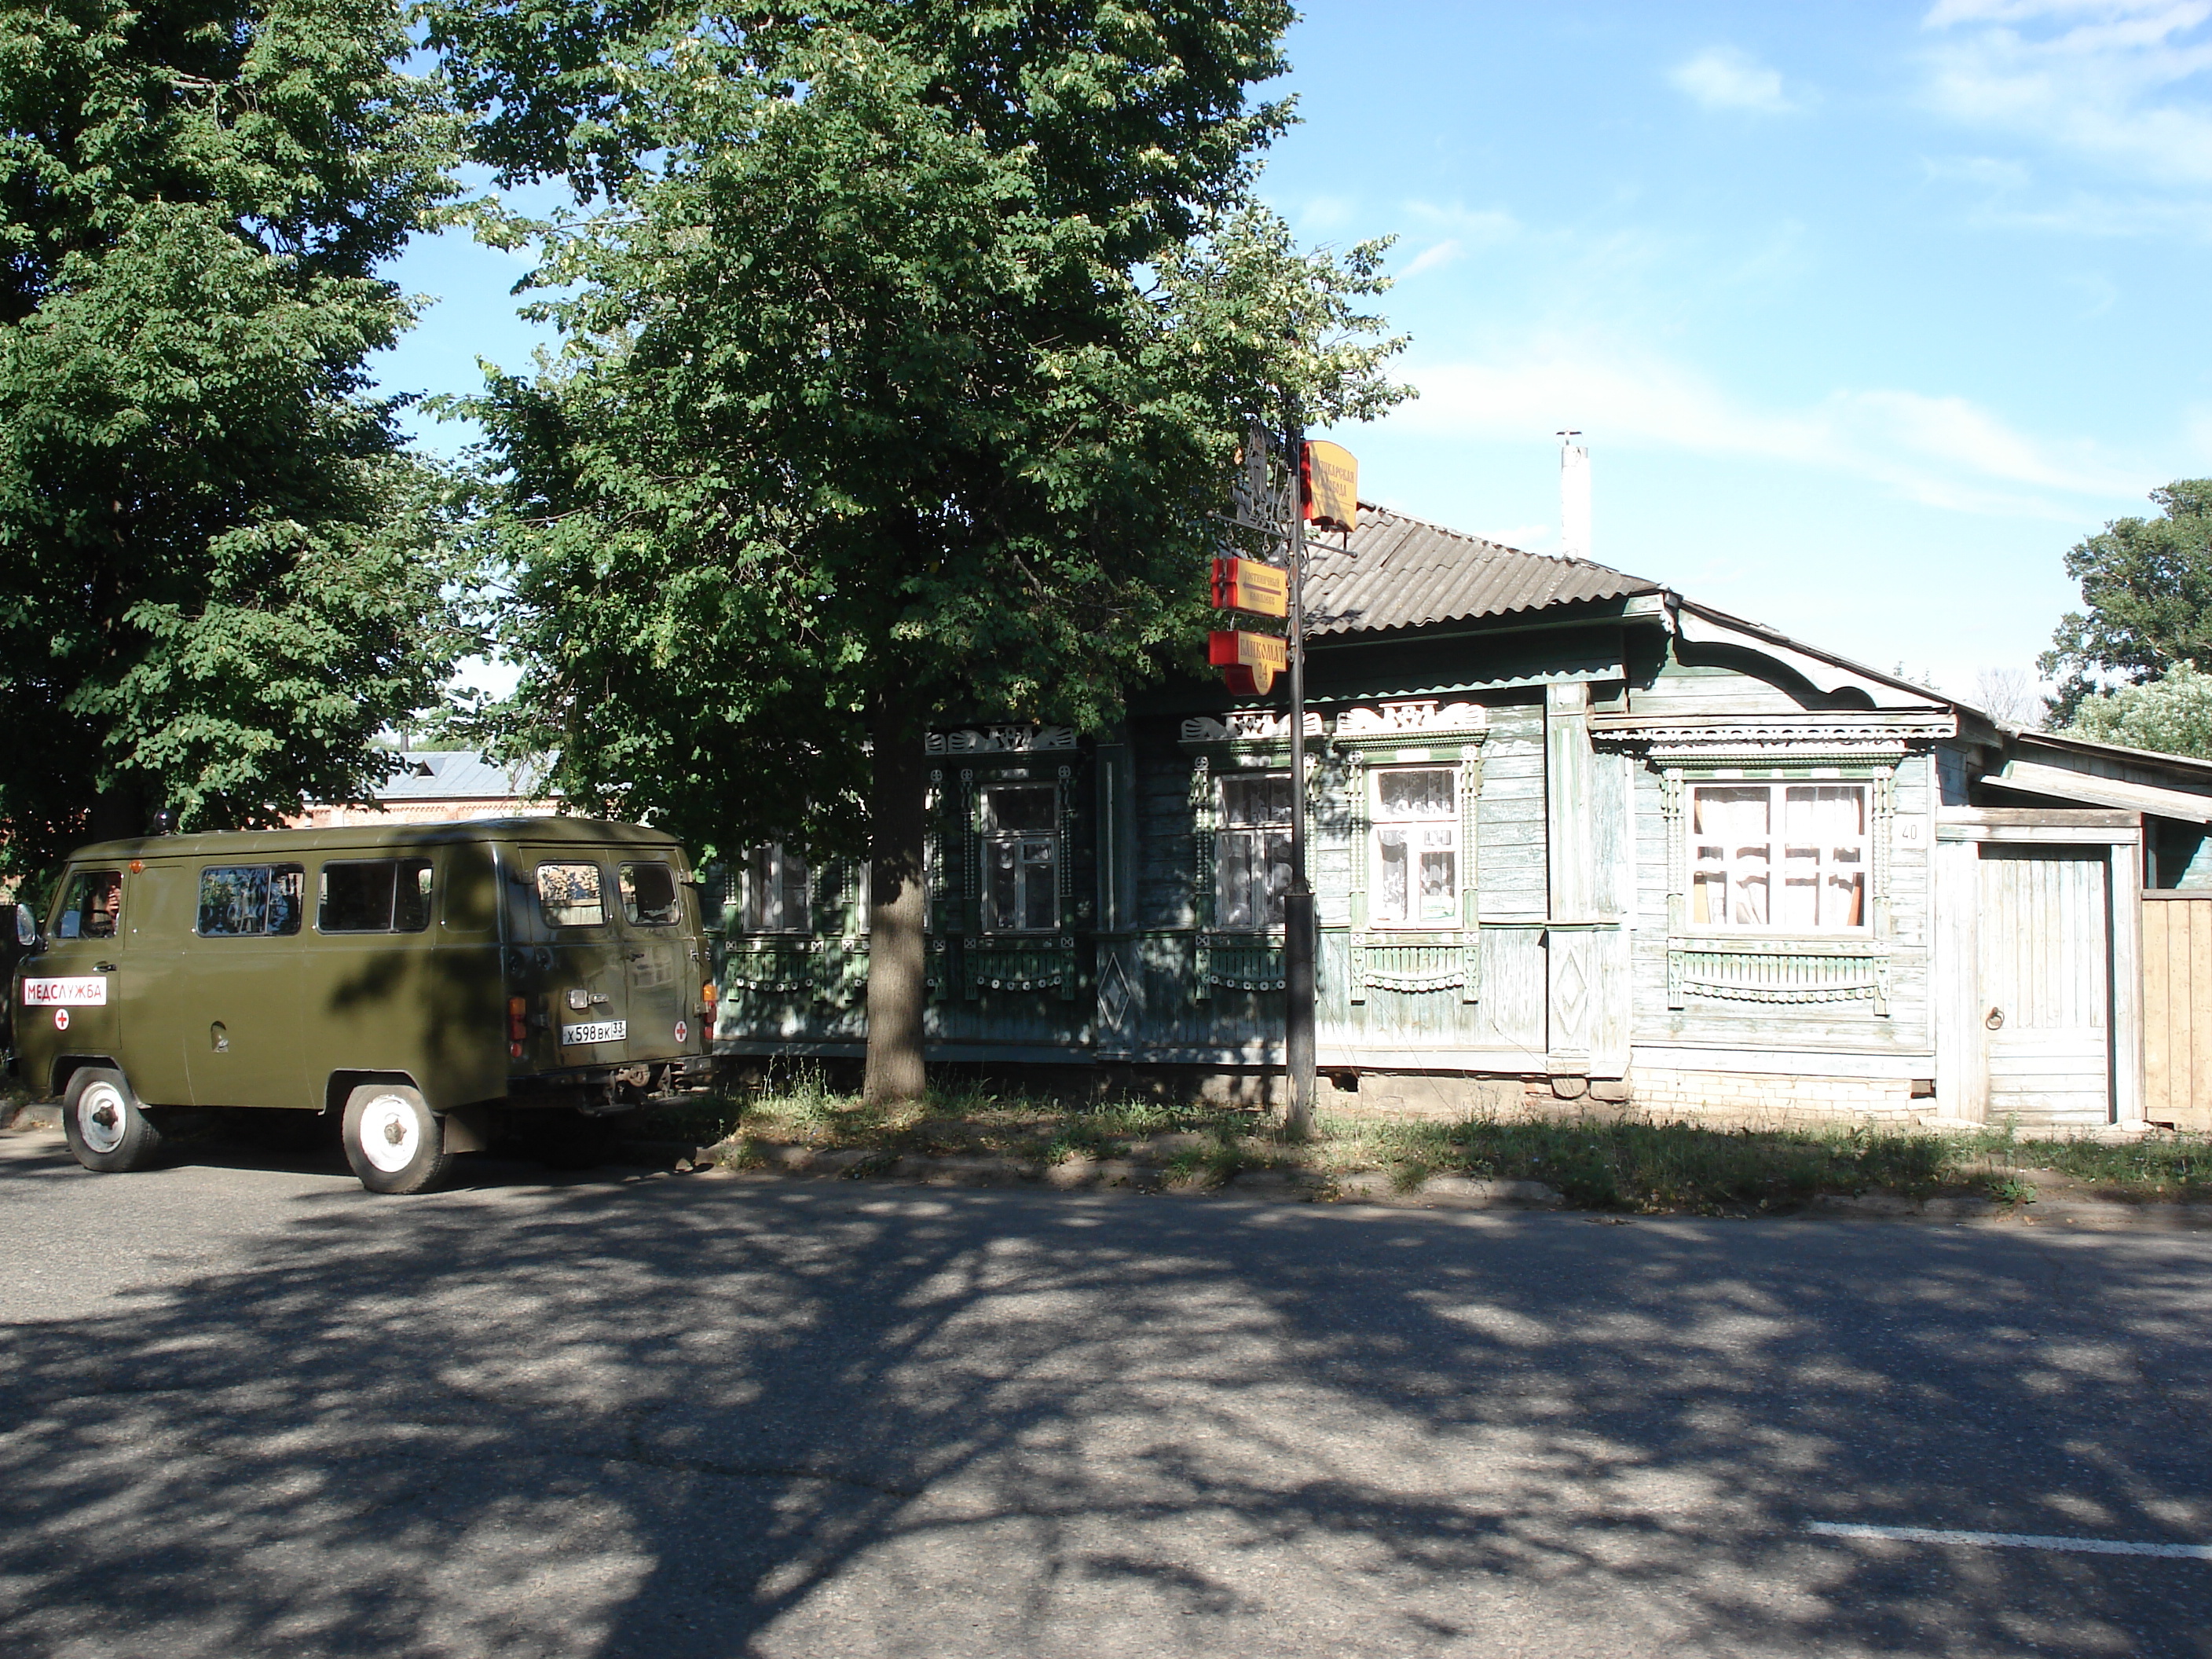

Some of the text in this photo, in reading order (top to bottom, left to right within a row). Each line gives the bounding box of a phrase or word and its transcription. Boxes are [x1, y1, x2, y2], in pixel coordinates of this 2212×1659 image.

[1240, 639, 1285, 663] БАНКОМАТ
[1258, 661, 1269, 681] 24
[1902, 824, 1917, 840] 40
[27, 983, 102, 1002] МЕДСЛУЖБА
[613, 1021, 623, 1034] 33
